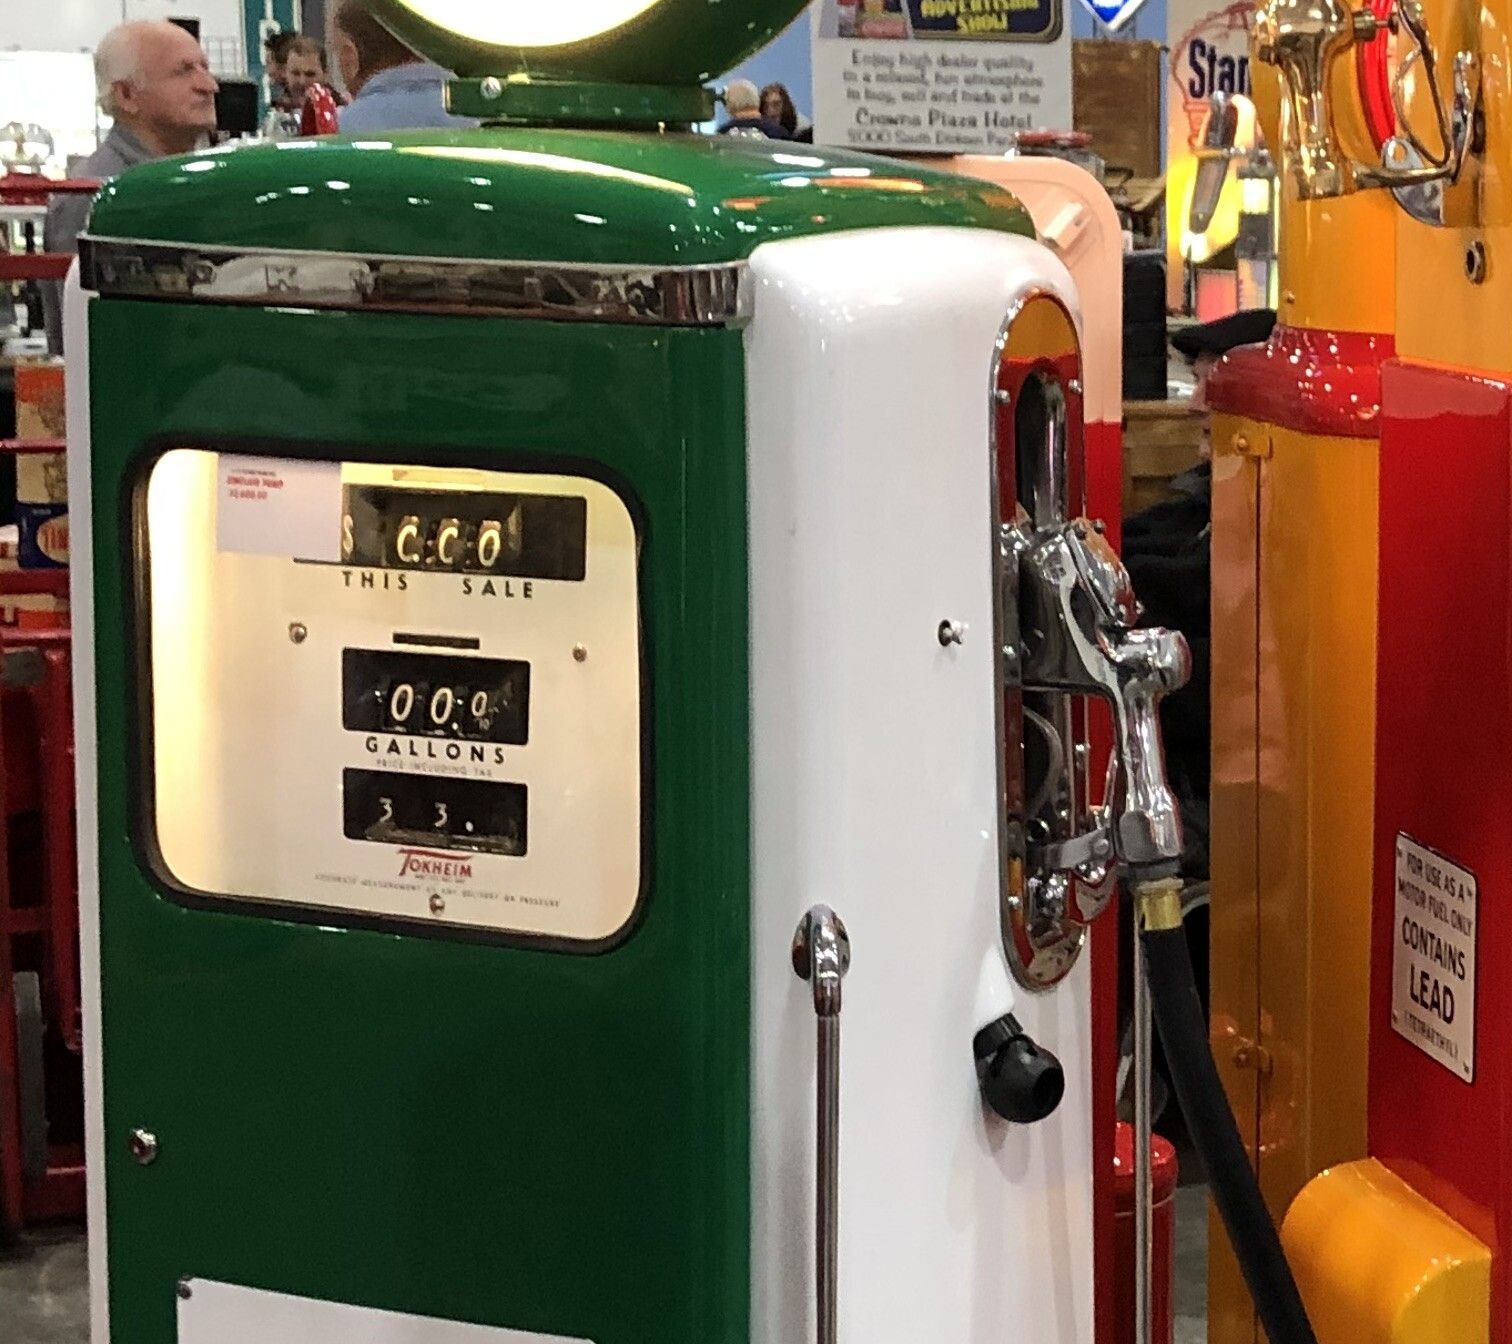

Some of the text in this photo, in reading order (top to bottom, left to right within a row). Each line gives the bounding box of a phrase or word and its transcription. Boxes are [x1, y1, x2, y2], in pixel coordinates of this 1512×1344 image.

[928, 108, 979, 129] Plaza
[984, 108, 1034, 130] Hotel
[342, 570, 534, 600] THIS SALE
[365, 735, 506, 765] GALLONS
[1407, 852, 1465, 903] FOR USE AS A
[1399, 875, 1473, 937] MOTOR FUEL ONLY
[1401, 916, 1466, 982] CONTAINS
[1409, 962, 1456, 1026] LEAD
